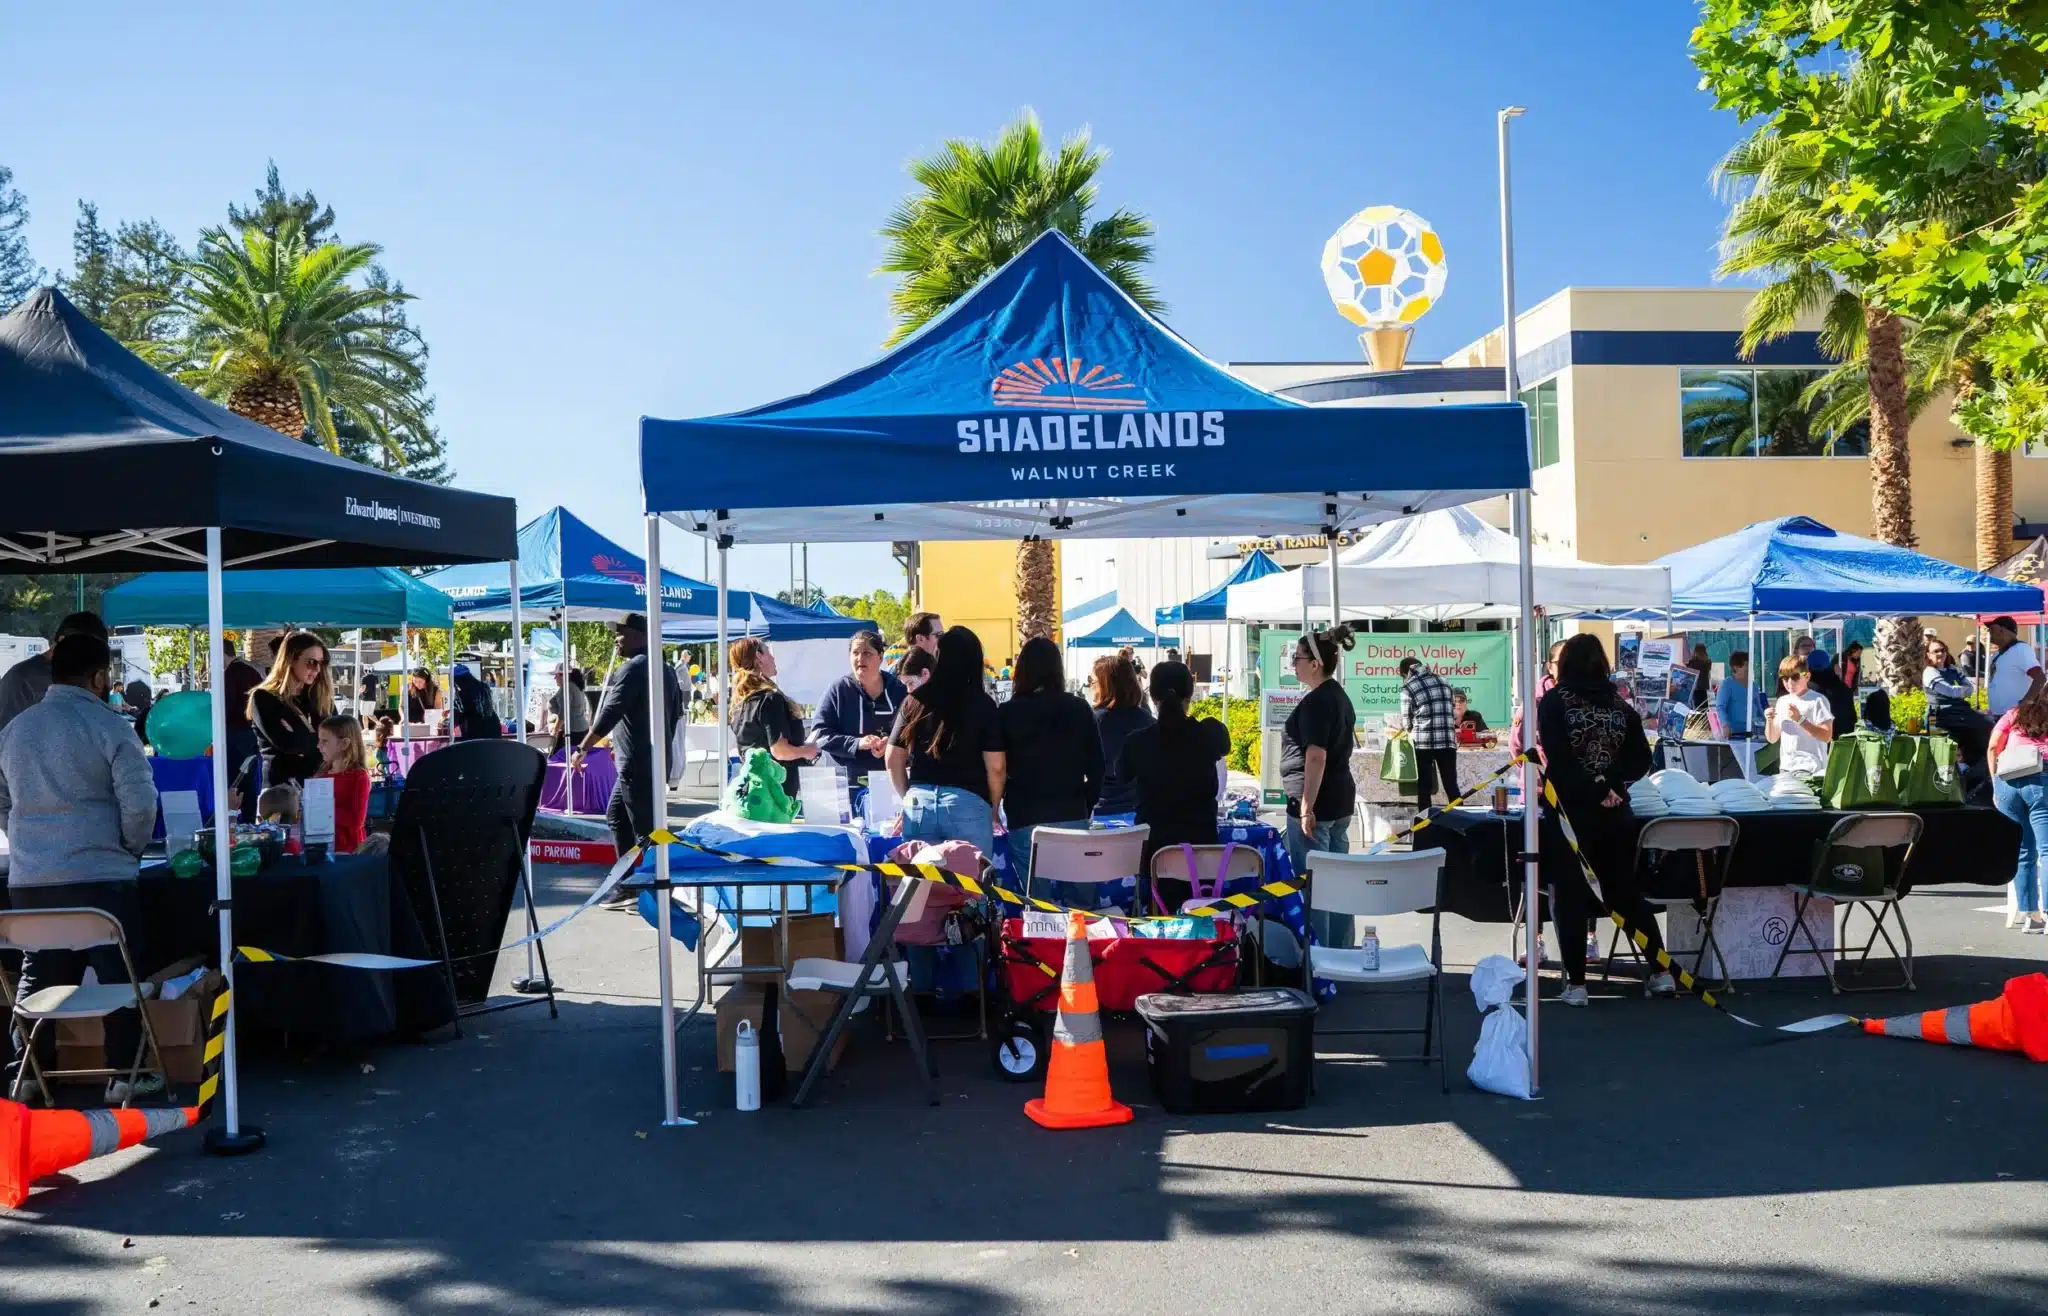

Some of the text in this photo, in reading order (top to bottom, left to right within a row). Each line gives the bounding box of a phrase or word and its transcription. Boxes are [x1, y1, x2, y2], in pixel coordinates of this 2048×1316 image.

[957, 411, 1225, 453] SHADELANDS
[1011, 463, 1177, 481] WALNUT CREEK
[401, 510, 440, 529] INVESTMENTS
[1236, 538, 1277, 552] SOCCER
[1283, 533, 1348, 550] TRAINIG
[634, 583, 693, 600] SHELANDS
[1368, 645, 1466, 662] Diablo Valley
[1355, 662, 1478, 676] Farme Market
[1362, 684, 1403, 694] Saturda
[1361, 697, 1401, 705] Year Roun
[544, 846, 581, 860] PARKING
